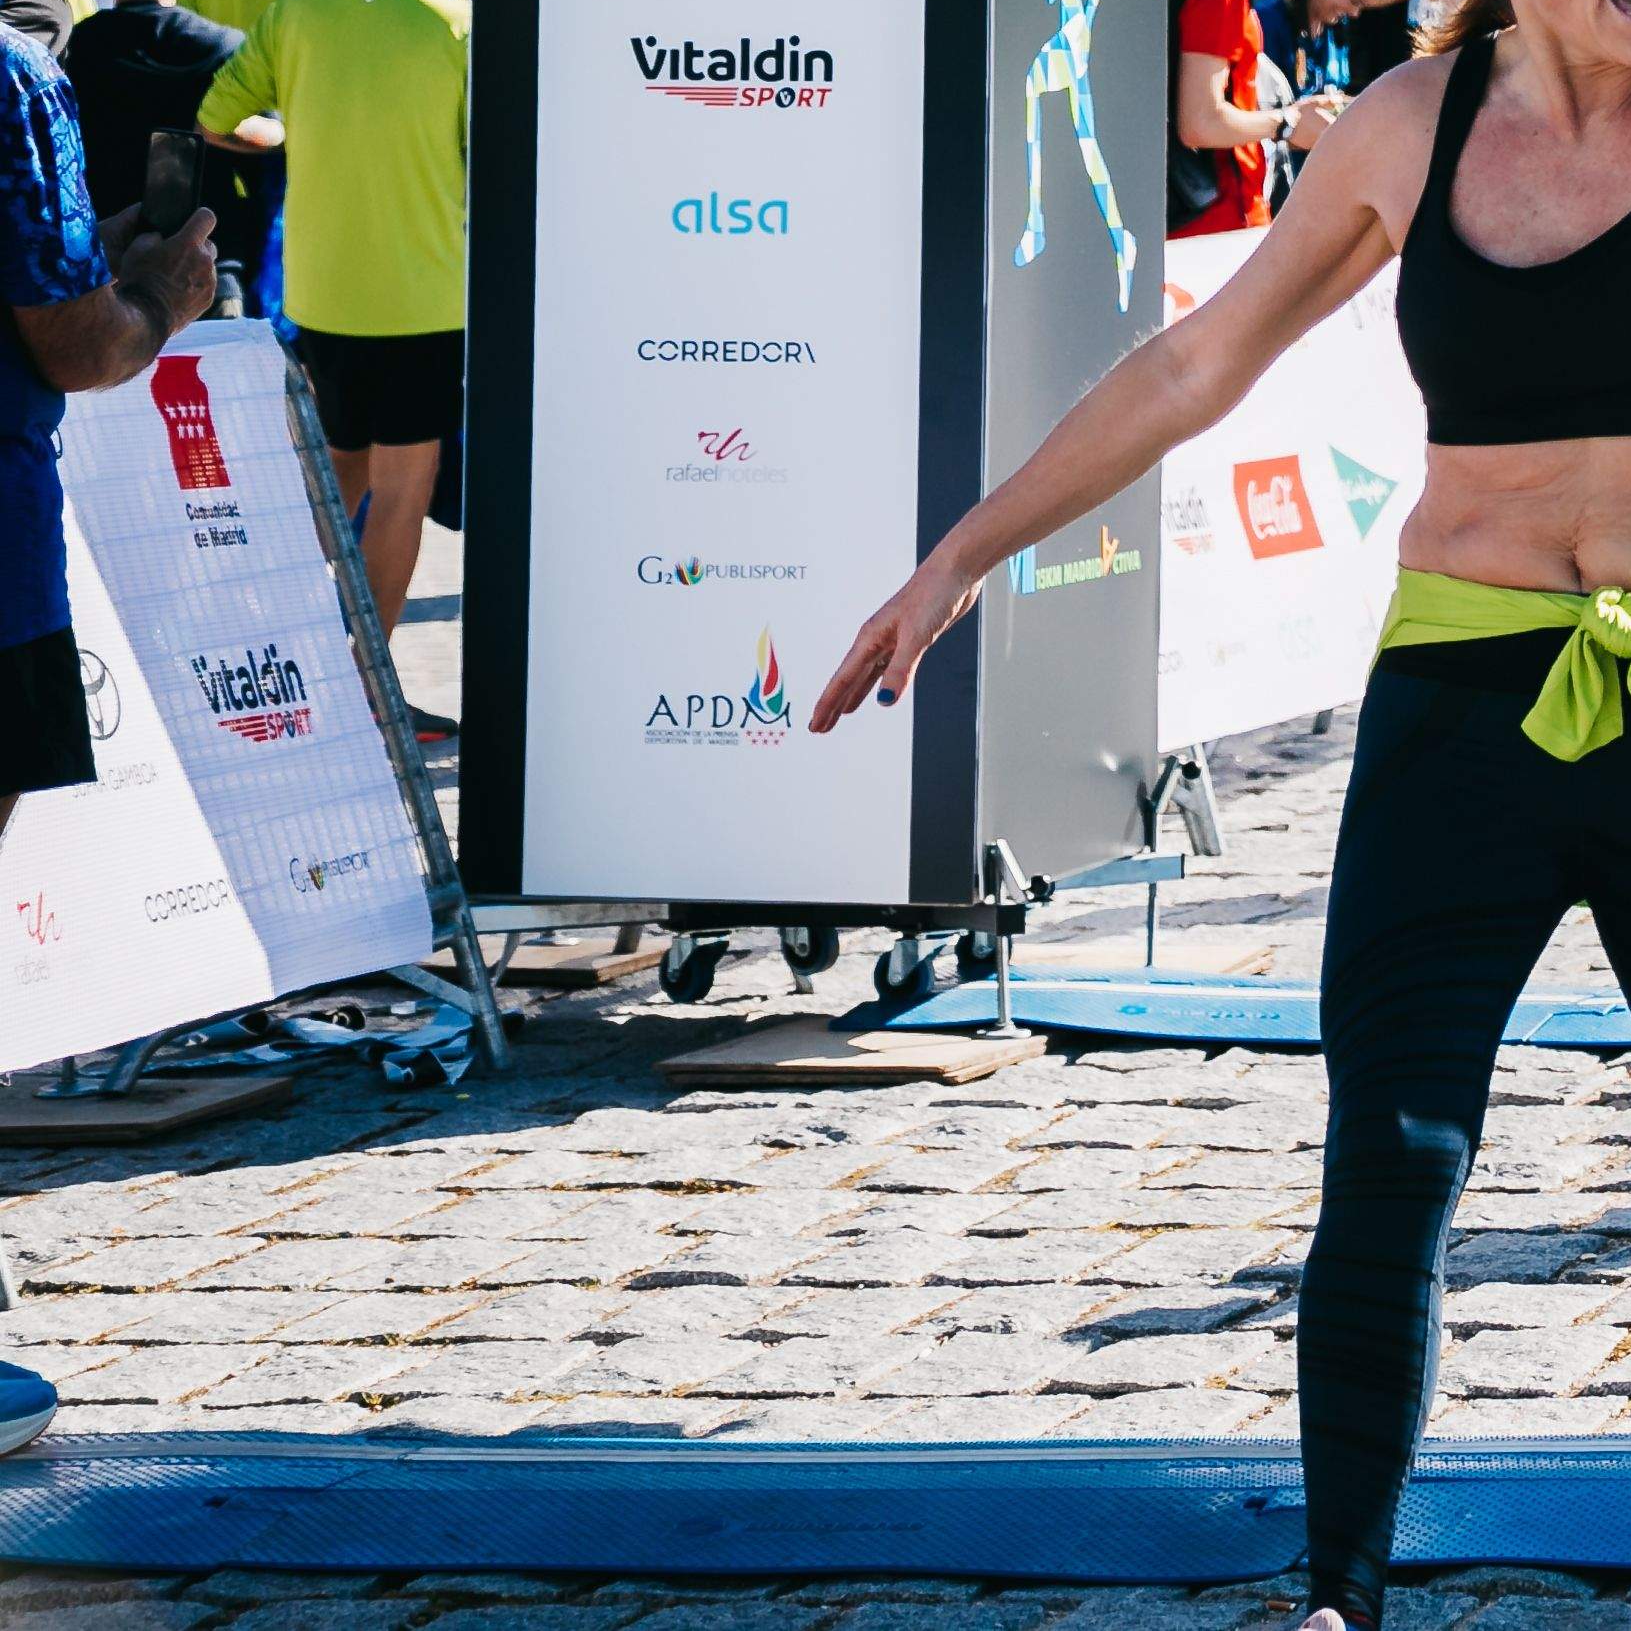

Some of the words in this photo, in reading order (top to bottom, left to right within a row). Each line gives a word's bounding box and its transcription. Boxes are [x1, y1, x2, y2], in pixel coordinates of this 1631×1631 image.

[630, 35, 834, 82] Vitaldin
[739, 87, 832, 109] SPORT
[672, 191, 788, 235] alsa
[706, 564, 808, 579] PUBLISPORT
[191, 643, 307, 714] Vitaldin
